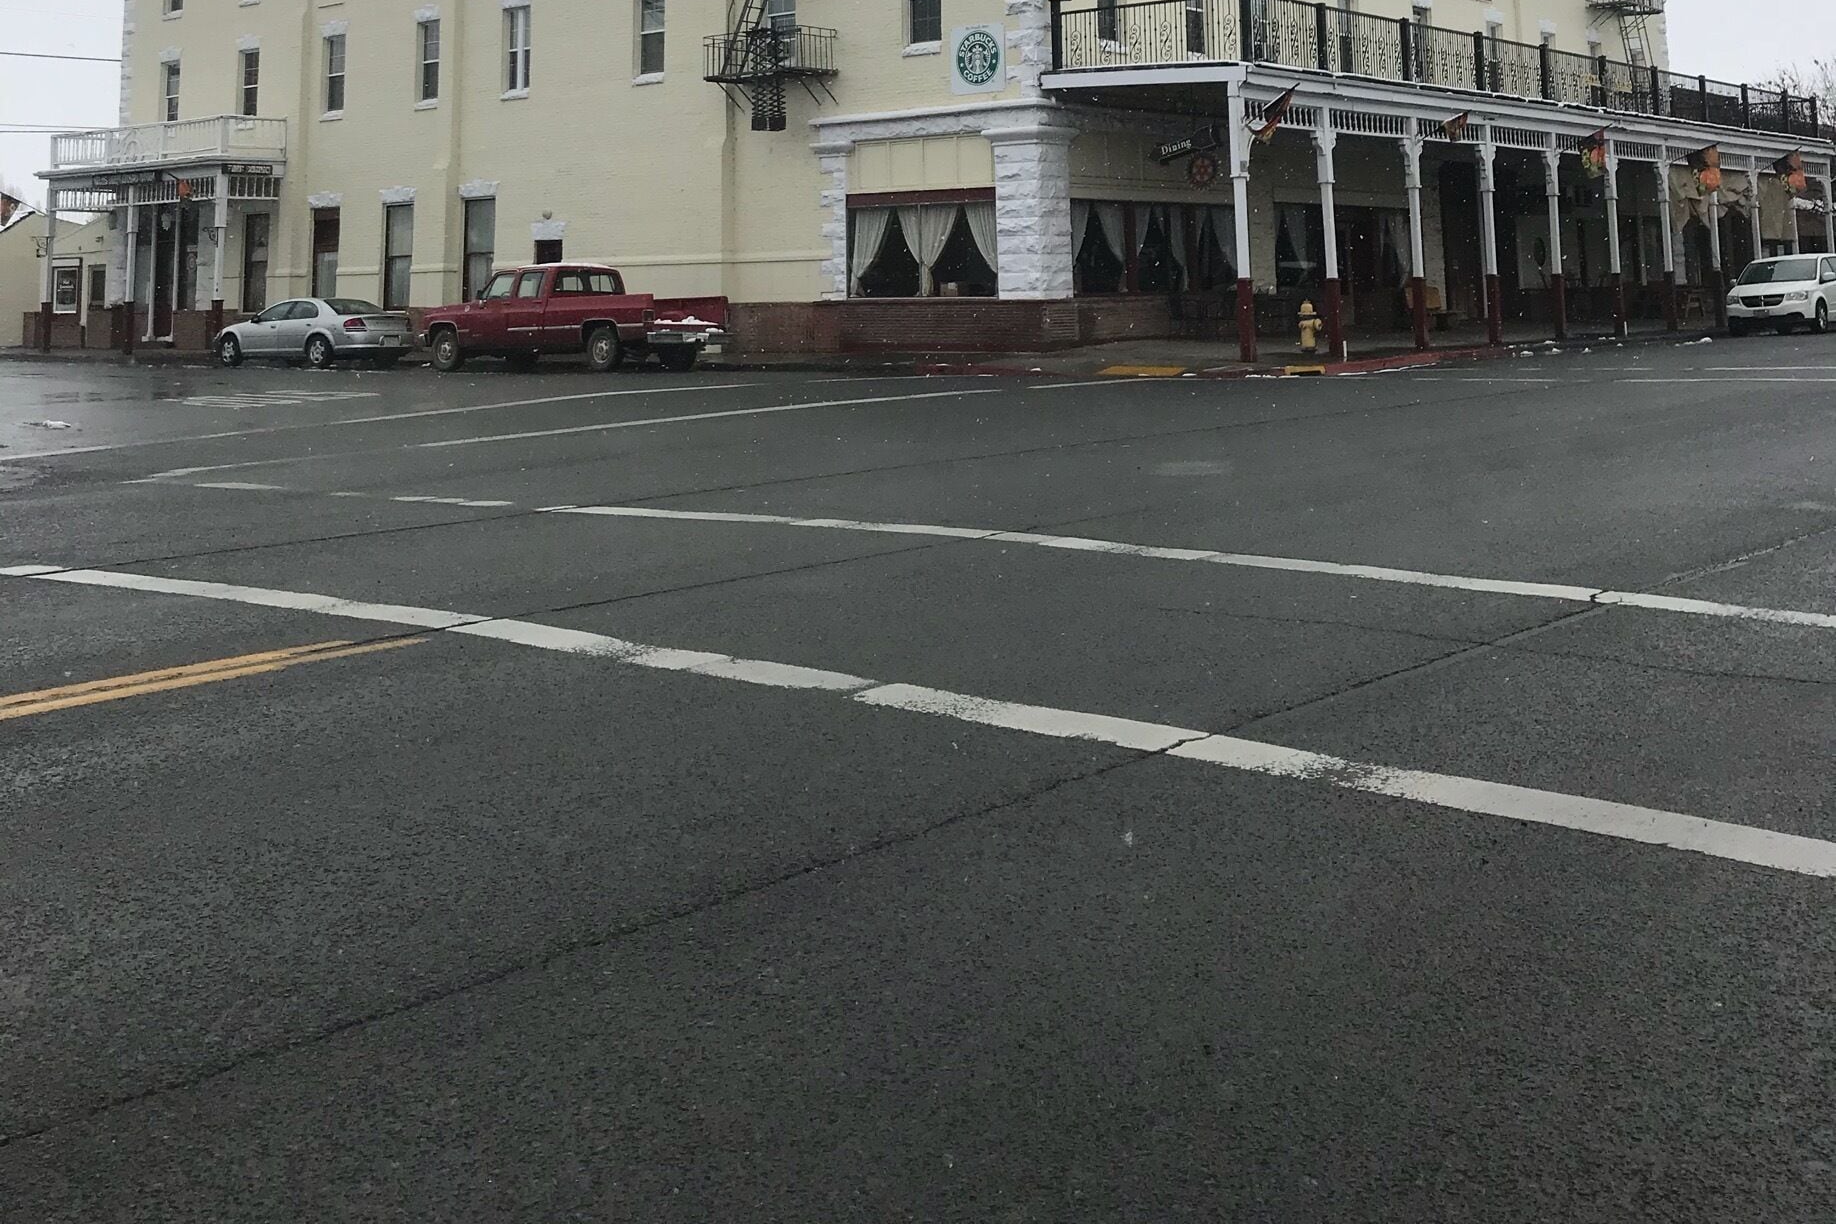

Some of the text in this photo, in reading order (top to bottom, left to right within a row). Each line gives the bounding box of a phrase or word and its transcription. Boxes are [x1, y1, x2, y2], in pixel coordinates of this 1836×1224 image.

[958, 33, 997, 57] STARBUCKS
[963, 67, 994, 83] COFFEE
[1161, 139, 1192, 155] Dining
